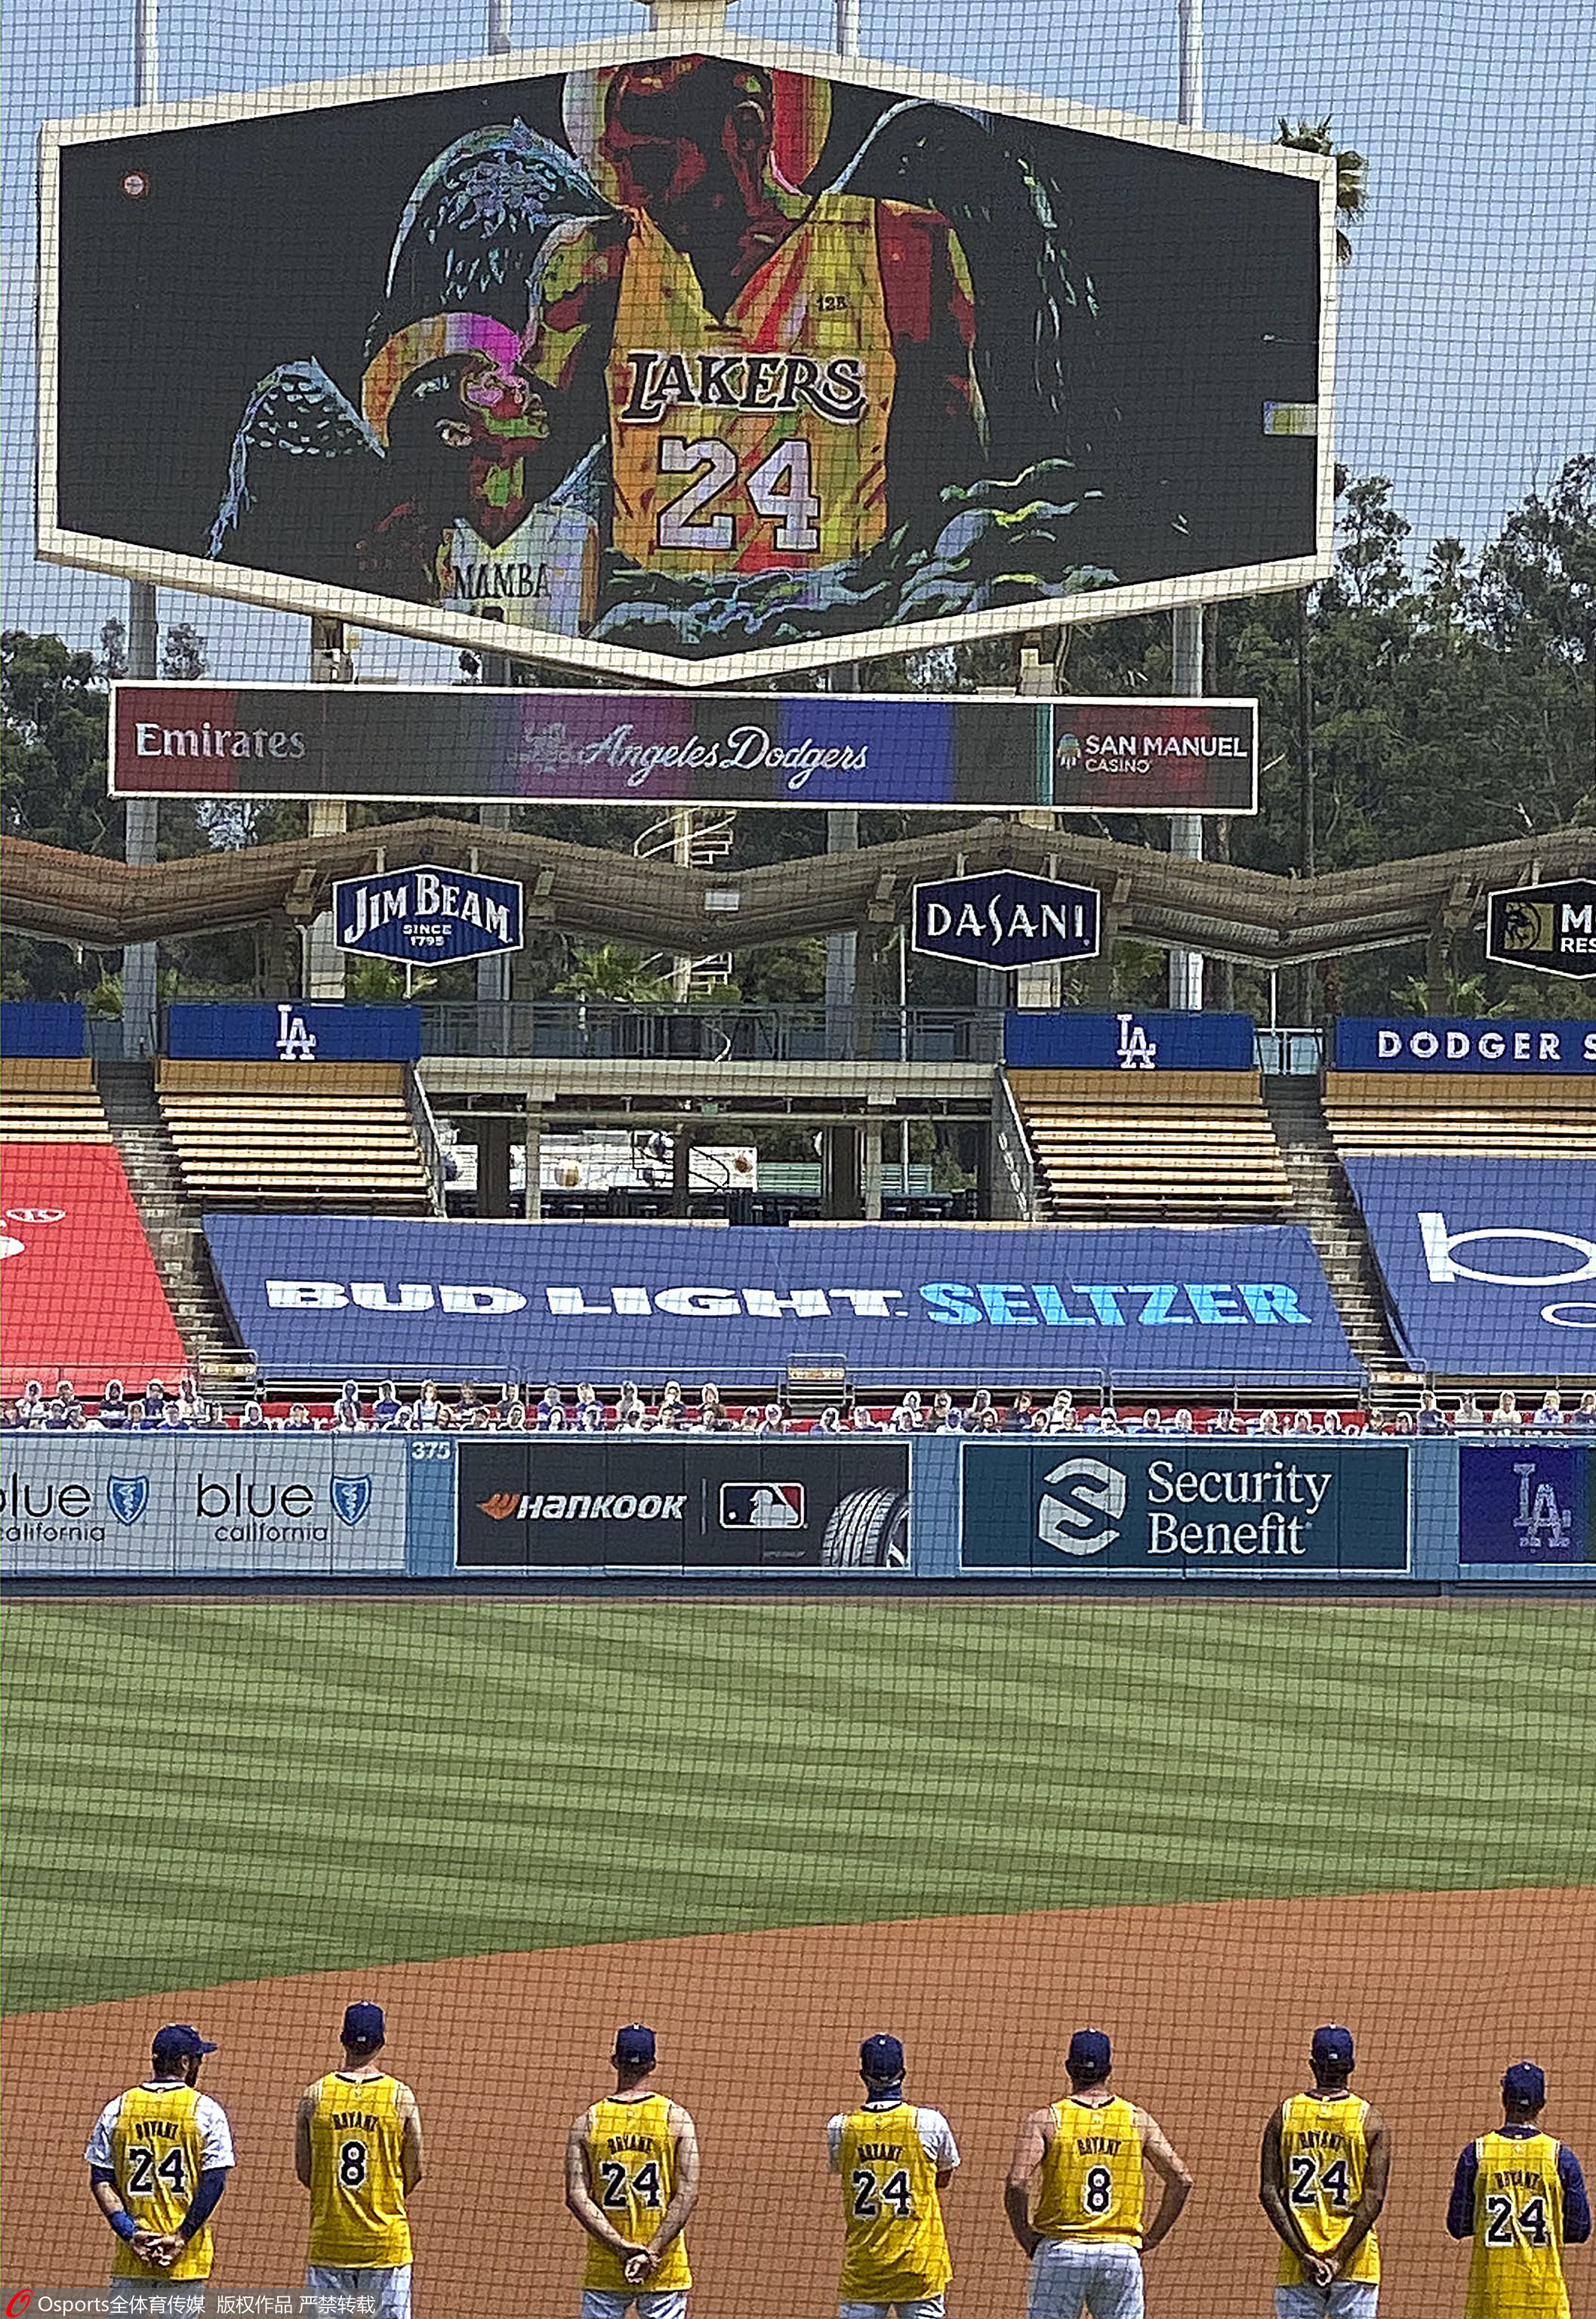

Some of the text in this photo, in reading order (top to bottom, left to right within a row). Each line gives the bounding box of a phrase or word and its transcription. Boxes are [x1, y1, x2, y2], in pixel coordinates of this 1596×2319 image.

[621, 350, 866, 424] LAKERS
[656, 436, 822, 551] 24
[445, 562, 552, 600] MAMBA
[135, 722, 305, 758] Emirates
[580, 723, 719, 787] Angeles
[723, 725, 868, 790] Dodgers
[1085, 735, 1248, 757] SAN MANUEL
[1085, 758, 1151, 773] CASINO
[344, 873, 510, 944] JIM BEAM
[402, 924, 452, 935] SINCE
[926, 894, 1084, 947] DASANI
[410, 936, 444, 947] 1795
[276, 1004, 317, 1061] LA
[1117, 1014, 1157, 1069] LA
[1378, 1030, 1561, 1061] DODGER
[265, 1279, 528, 1314] BUD
[918, 1282, 1313, 1326] SELTZER
[411, 1441, 451, 1460] 375
[0, 1471, 91, 1518] lue
[196, 1473, 315, 1518] blue
[1148, 1461, 1332, 1514] Security
[1513, 1462, 1571, 1548] LA
[214, 1521, 328, 1542] california
[1148, 1512, 1307, 1554] Benefit
[128, 2146, 186, 2195] 24
[340, 2139, 368, 2188] 8
[600, 2160, 661, 2209] 24
[1290, 2155, 1349, 2207] 24
[852, 2169, 912, 2217] 24
[1084, 2165, 1113, 2215] 8
[1486, 2194, 1547, 2246] 24
